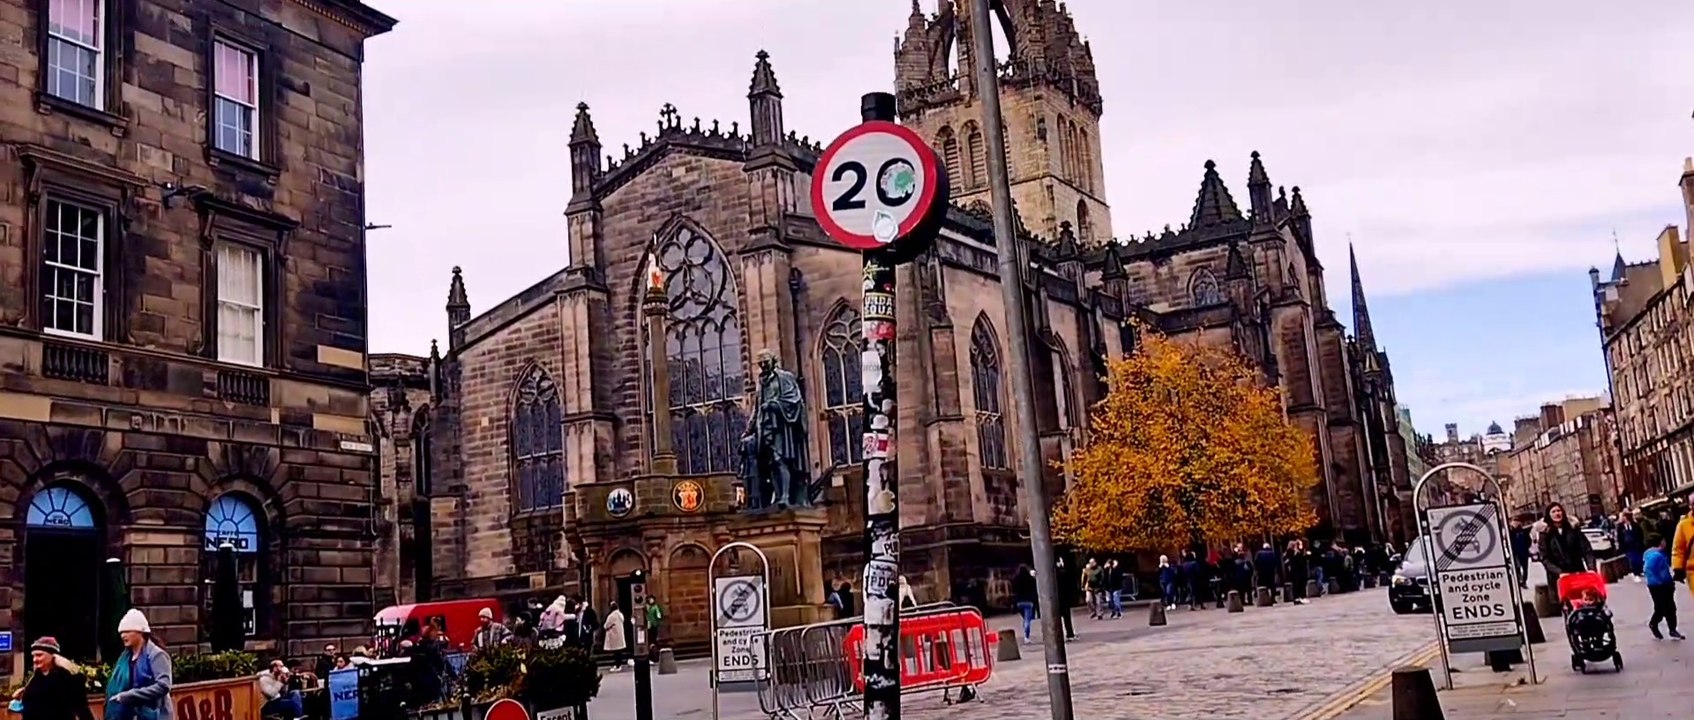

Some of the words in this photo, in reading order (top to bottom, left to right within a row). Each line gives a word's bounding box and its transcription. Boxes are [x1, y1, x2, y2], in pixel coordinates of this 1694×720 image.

[831, 157, 915, 211] 20
[206, 537, 249, 550] NERO
[1442, 571, 1503, 582] Pedestrian
[1448, 583, 1468, 592] and
[1471, 581, 1501, 592] cycle
[1462, 593, 1490, 603] Zone
[1452, 604, 1505, 619] ENDS
[723, 655, 758, 667] ENDS
